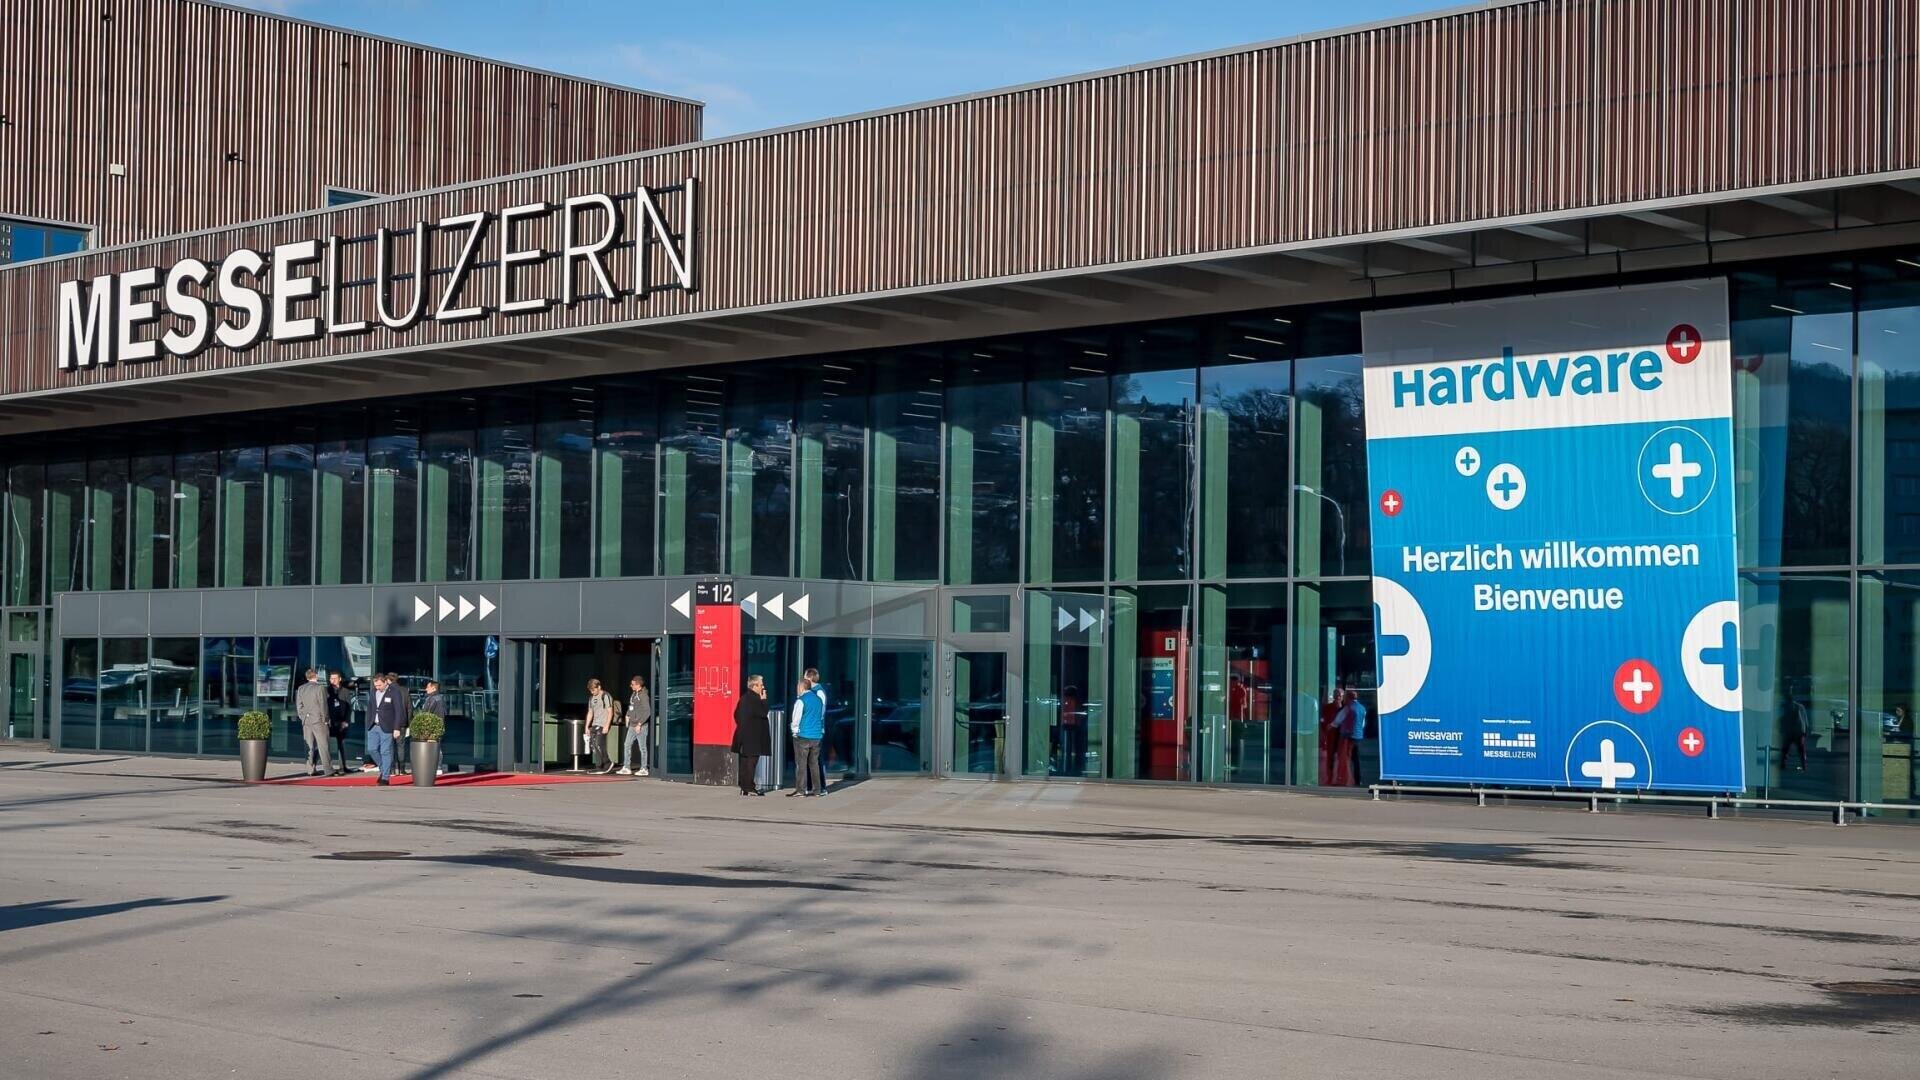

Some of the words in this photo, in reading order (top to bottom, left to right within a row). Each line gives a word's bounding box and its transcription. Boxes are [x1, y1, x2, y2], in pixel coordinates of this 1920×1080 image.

[58, 176, 698, 369] MESSELUZERN
[1393, 346, 1663, 408] Hardware
[1402, 543, 1513, 572] Herzlich
[1520, 540, 1699, 569] willkommen
[1474, 584, 1624, 611] Bienvenue
[1483, 750, 1537, 759] MESSELUZERN
